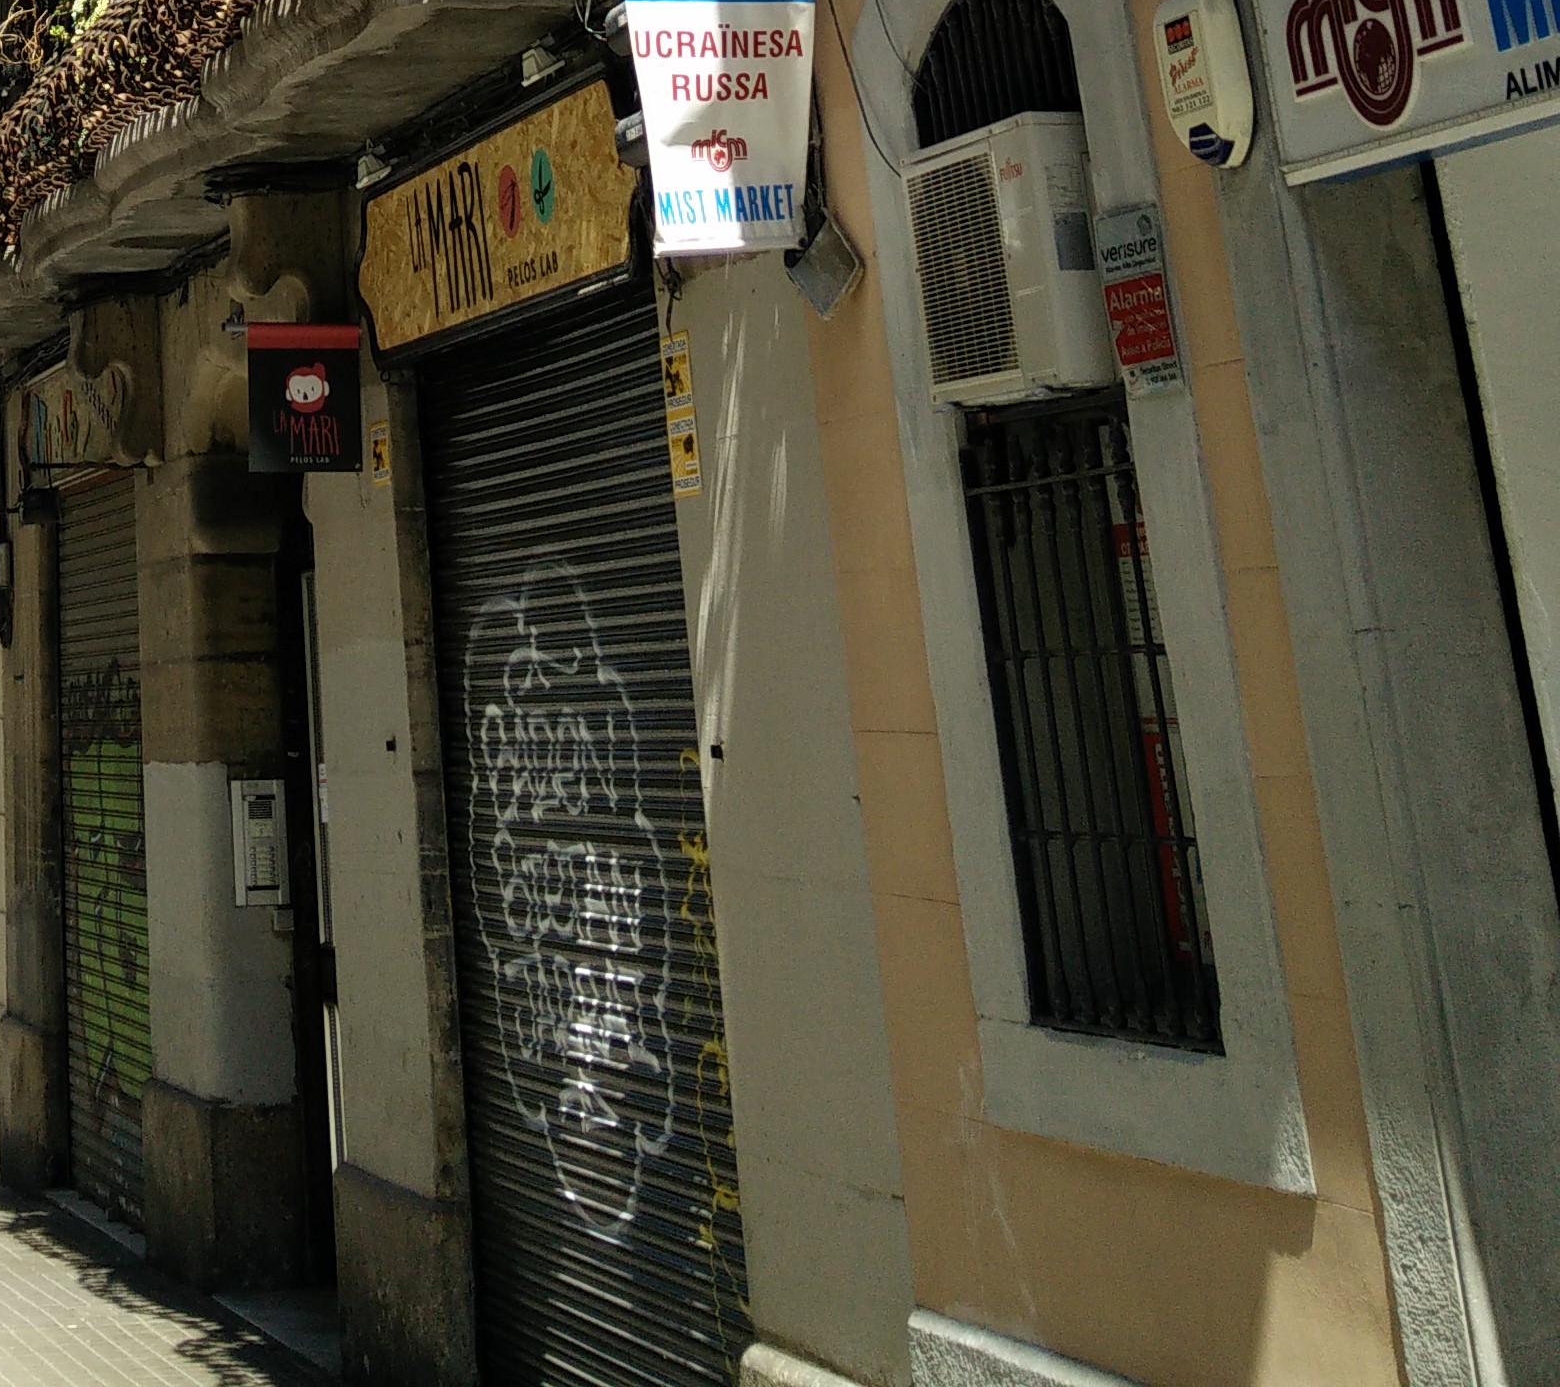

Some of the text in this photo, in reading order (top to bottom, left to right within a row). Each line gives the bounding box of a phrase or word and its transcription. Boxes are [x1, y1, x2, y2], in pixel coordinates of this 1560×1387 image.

[635, 23, 803, 59] UCRAÏNESA
[672, 73, 768, 101] RUSSA
[658, 183, 794, 227] MIST MARKET
[406, 162, 493, 319] LA MARI
[1101, 237, 1157, 263] verisure
[507, 251, 559, 288] PELOS LAB
[1109, 285, 1163, 311] Alarma
[273, 408, 339, 455] LA MARI
